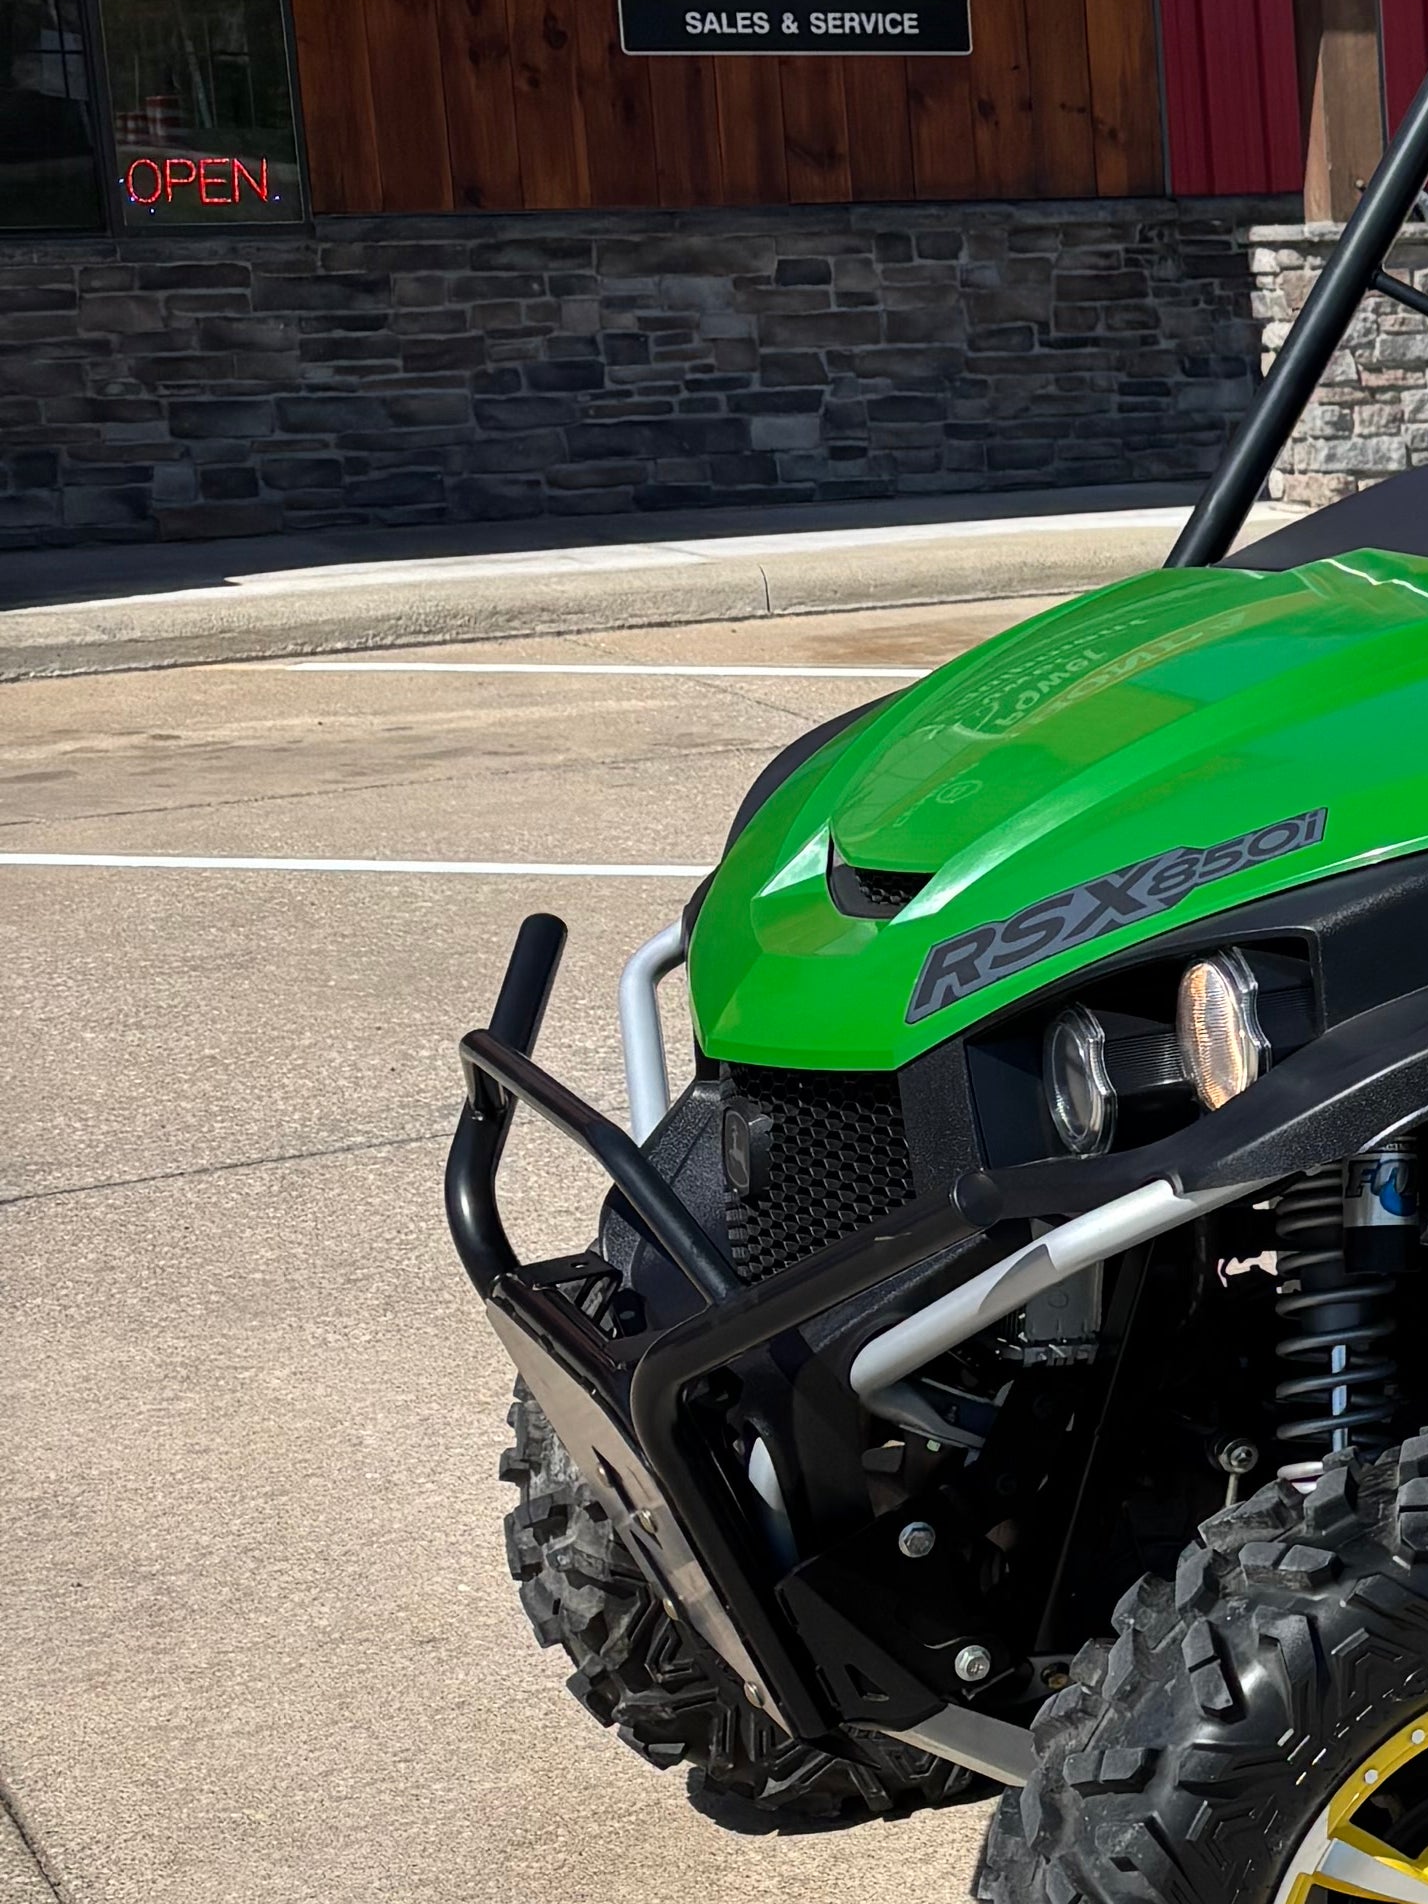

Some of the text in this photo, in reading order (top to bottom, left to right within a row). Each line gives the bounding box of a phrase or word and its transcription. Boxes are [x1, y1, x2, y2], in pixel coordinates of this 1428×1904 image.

[685, 12, 919, 34] SALES & SERVICE
[126, 158, 268, 205] OPEN
